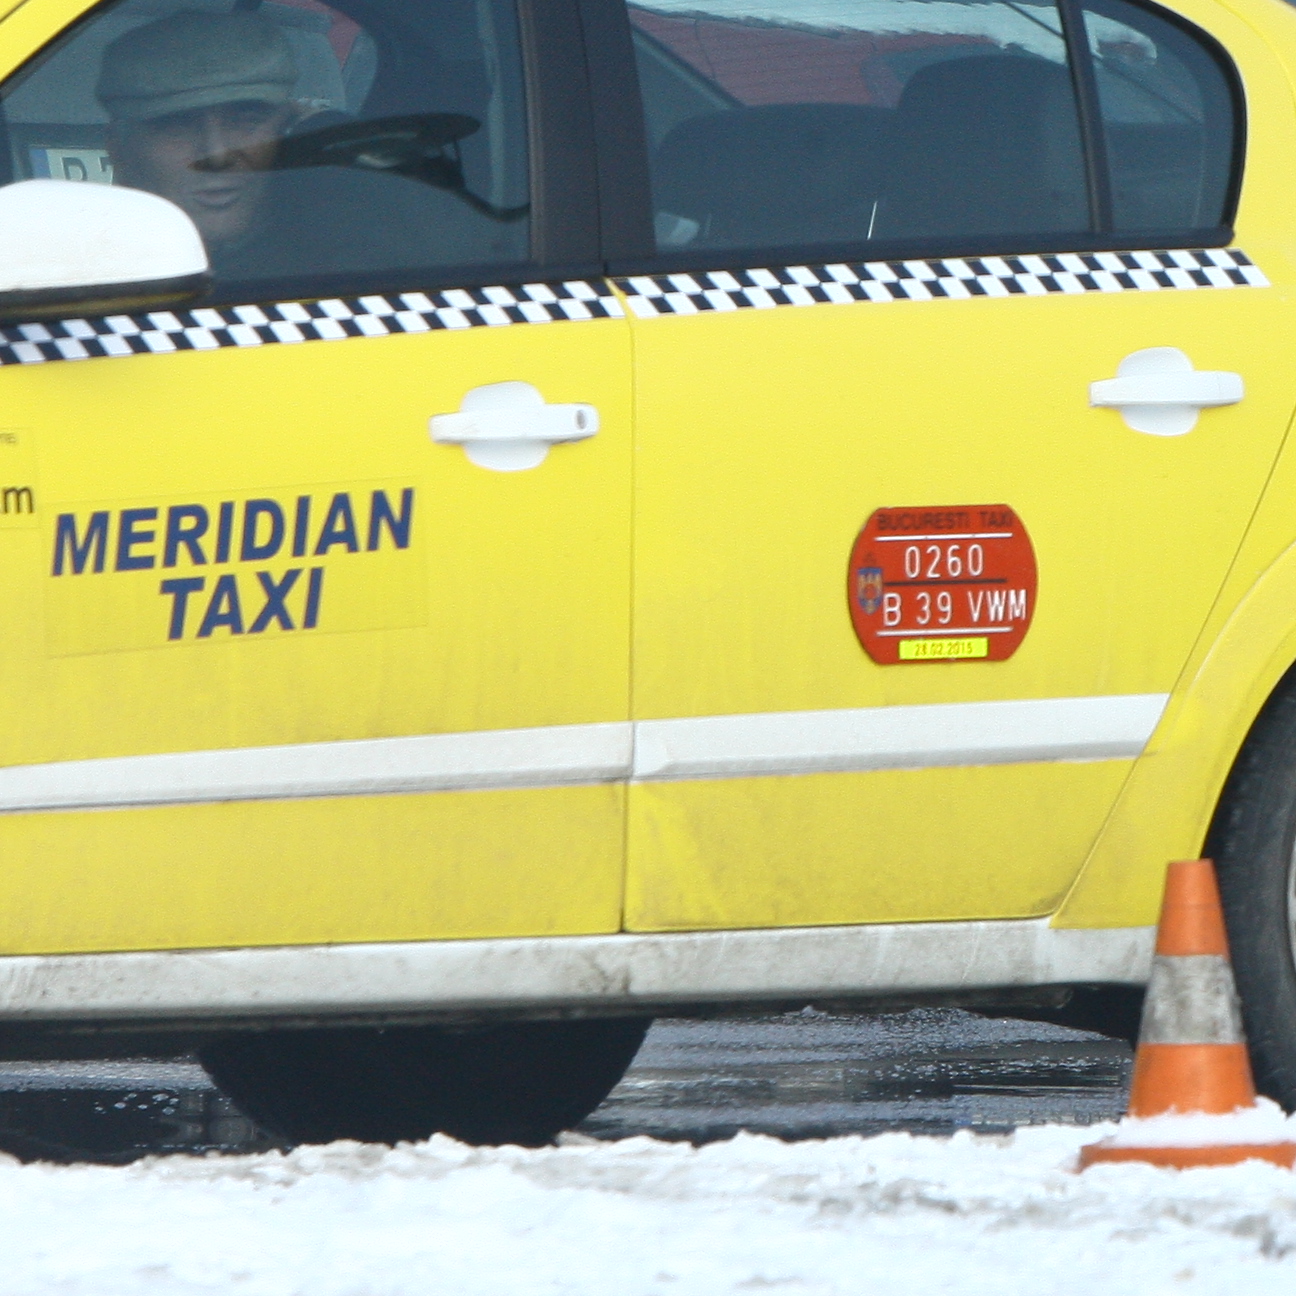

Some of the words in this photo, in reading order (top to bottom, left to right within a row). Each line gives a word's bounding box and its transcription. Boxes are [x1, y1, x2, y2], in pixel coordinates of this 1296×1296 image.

[50, 487, 415, 577] MERIDIAN
[904, 543, 984, 579] 0260
[159, 566, 325, 641] TAXI
[883, 592, 902, 627] B
[916, 591, 952, 625] 39
[967, 588, 1027, 623] VWM
